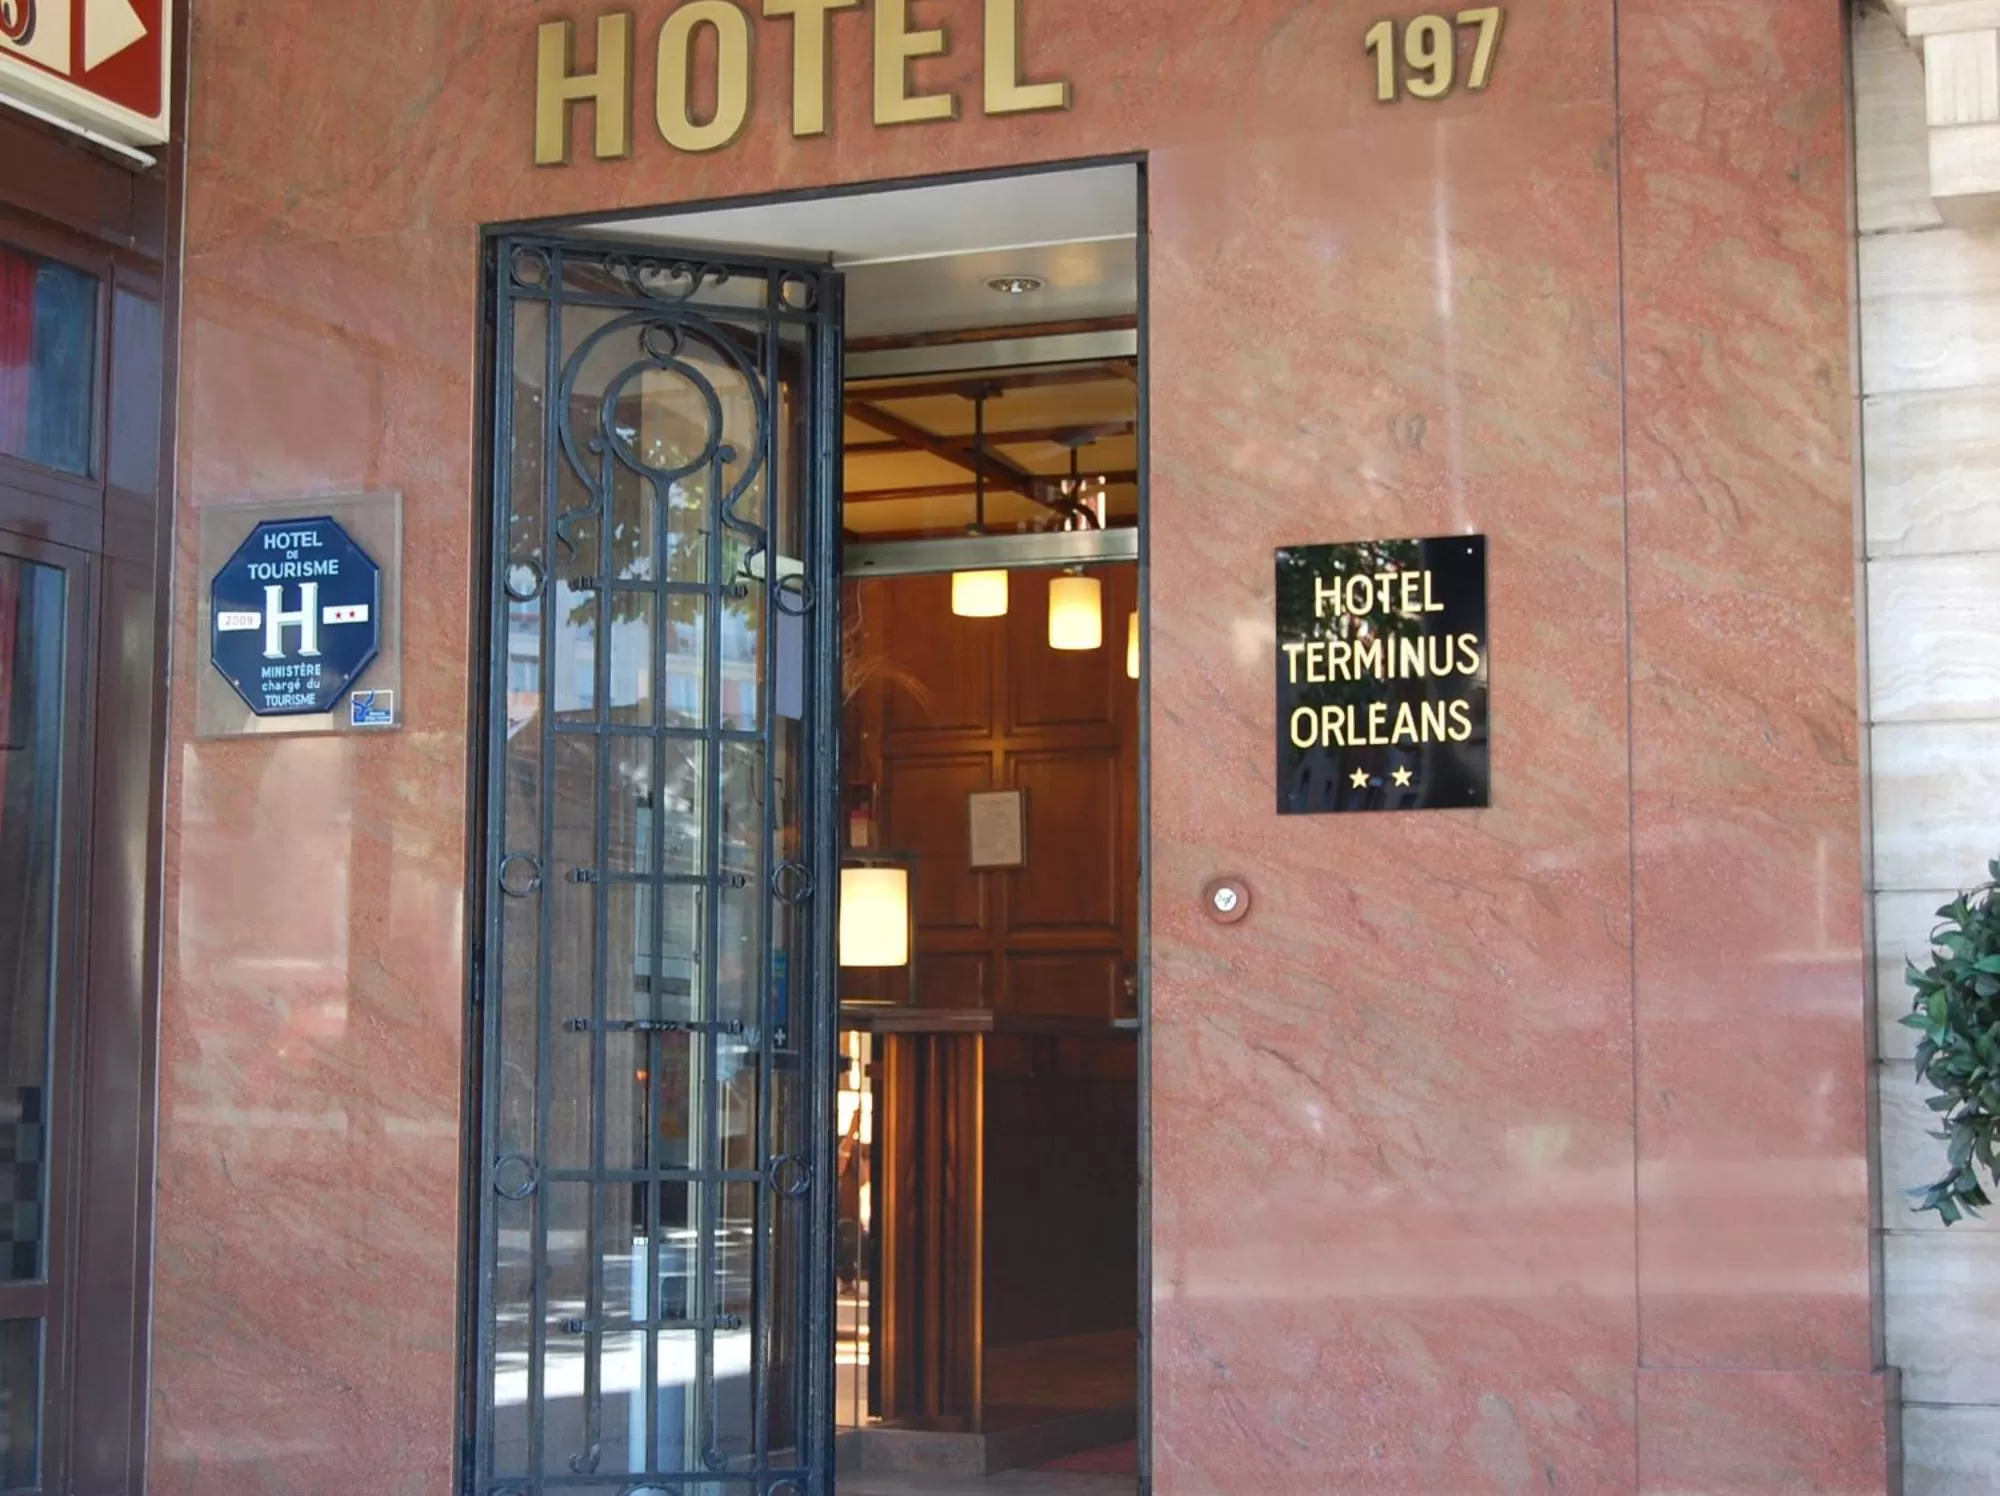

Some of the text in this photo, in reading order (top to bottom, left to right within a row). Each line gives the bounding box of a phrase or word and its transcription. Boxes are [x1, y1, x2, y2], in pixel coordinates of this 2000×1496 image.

[1365, 7, 1504, 101] 197
[535, 0, 1071, 166] HOTEL
[264, 531, 323, 549] HOTEL
[286, 550, 299, 560] DE
[248, 559, 339, 580] TOURISME
[1314, 570, 1444, 617] HOTEL
[263, 582, 321, 659] H
[1282, 633, 1480, 683] TERMINUS
[262, 677, 321, 693] chargé du
[265, 692, 316, 707] TOURISME
